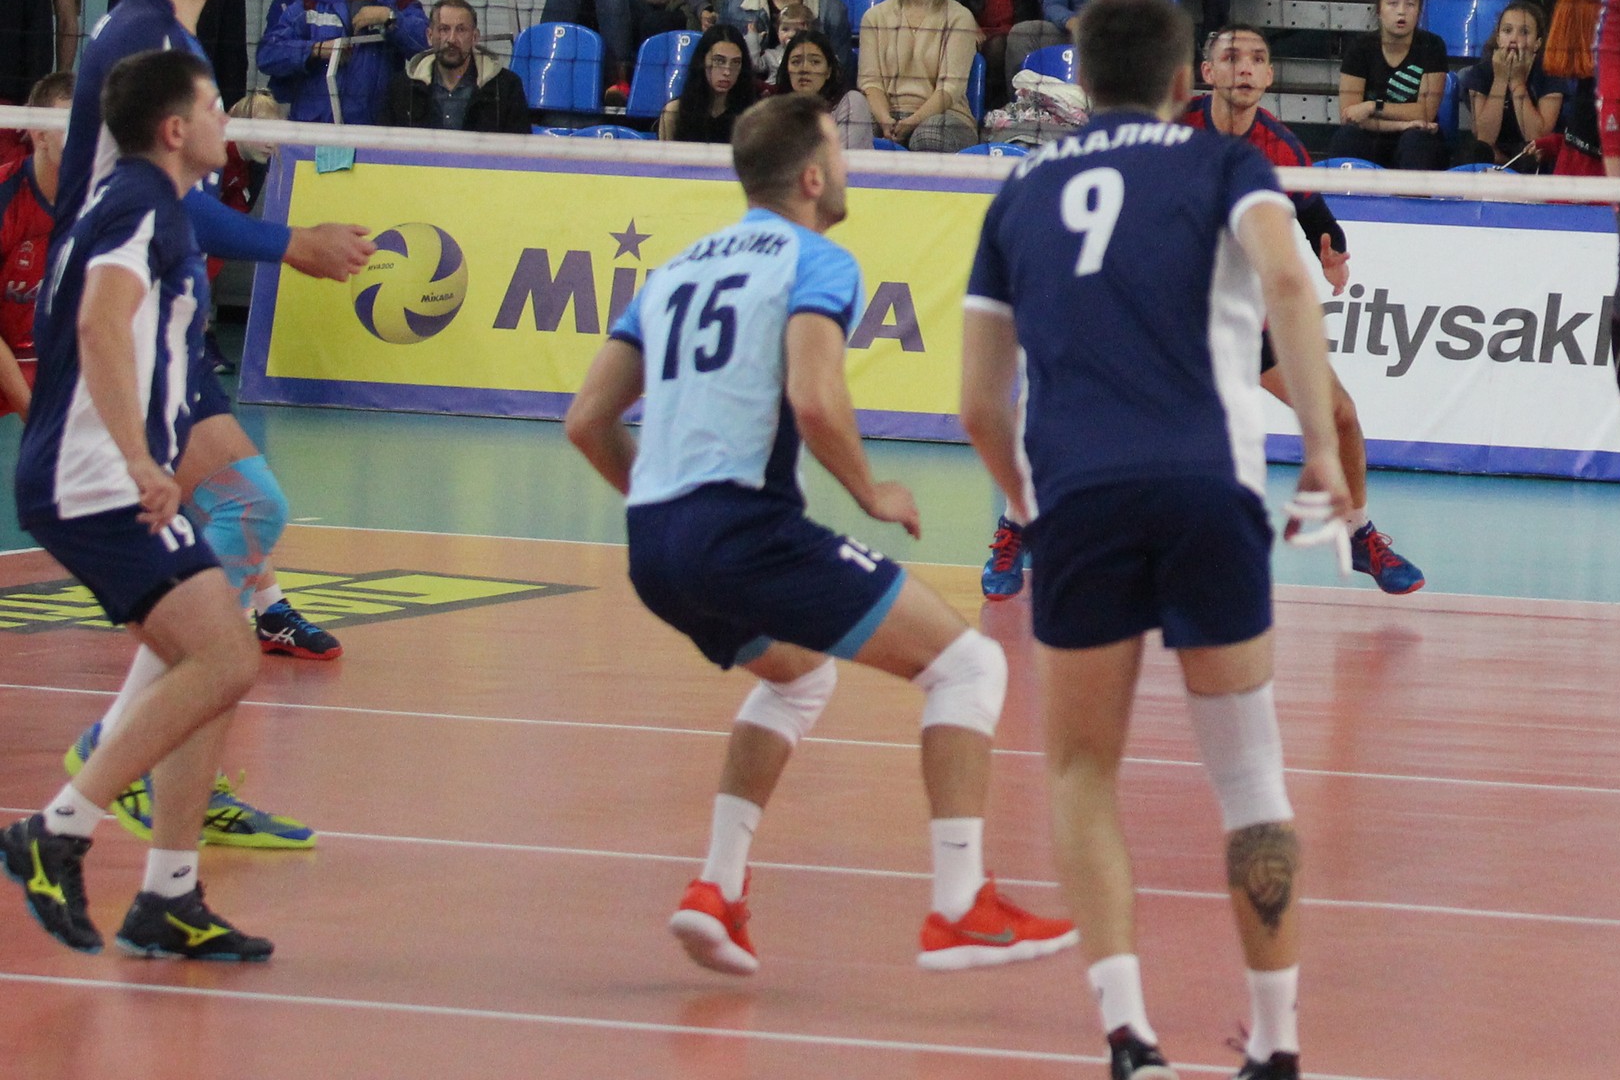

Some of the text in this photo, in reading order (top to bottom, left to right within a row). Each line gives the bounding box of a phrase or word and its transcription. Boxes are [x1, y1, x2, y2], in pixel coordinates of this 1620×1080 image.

[1060, 166, 1125, 277] 9
[661, 273, 750, 381] 15
[160, 514, 196, 552] 19
